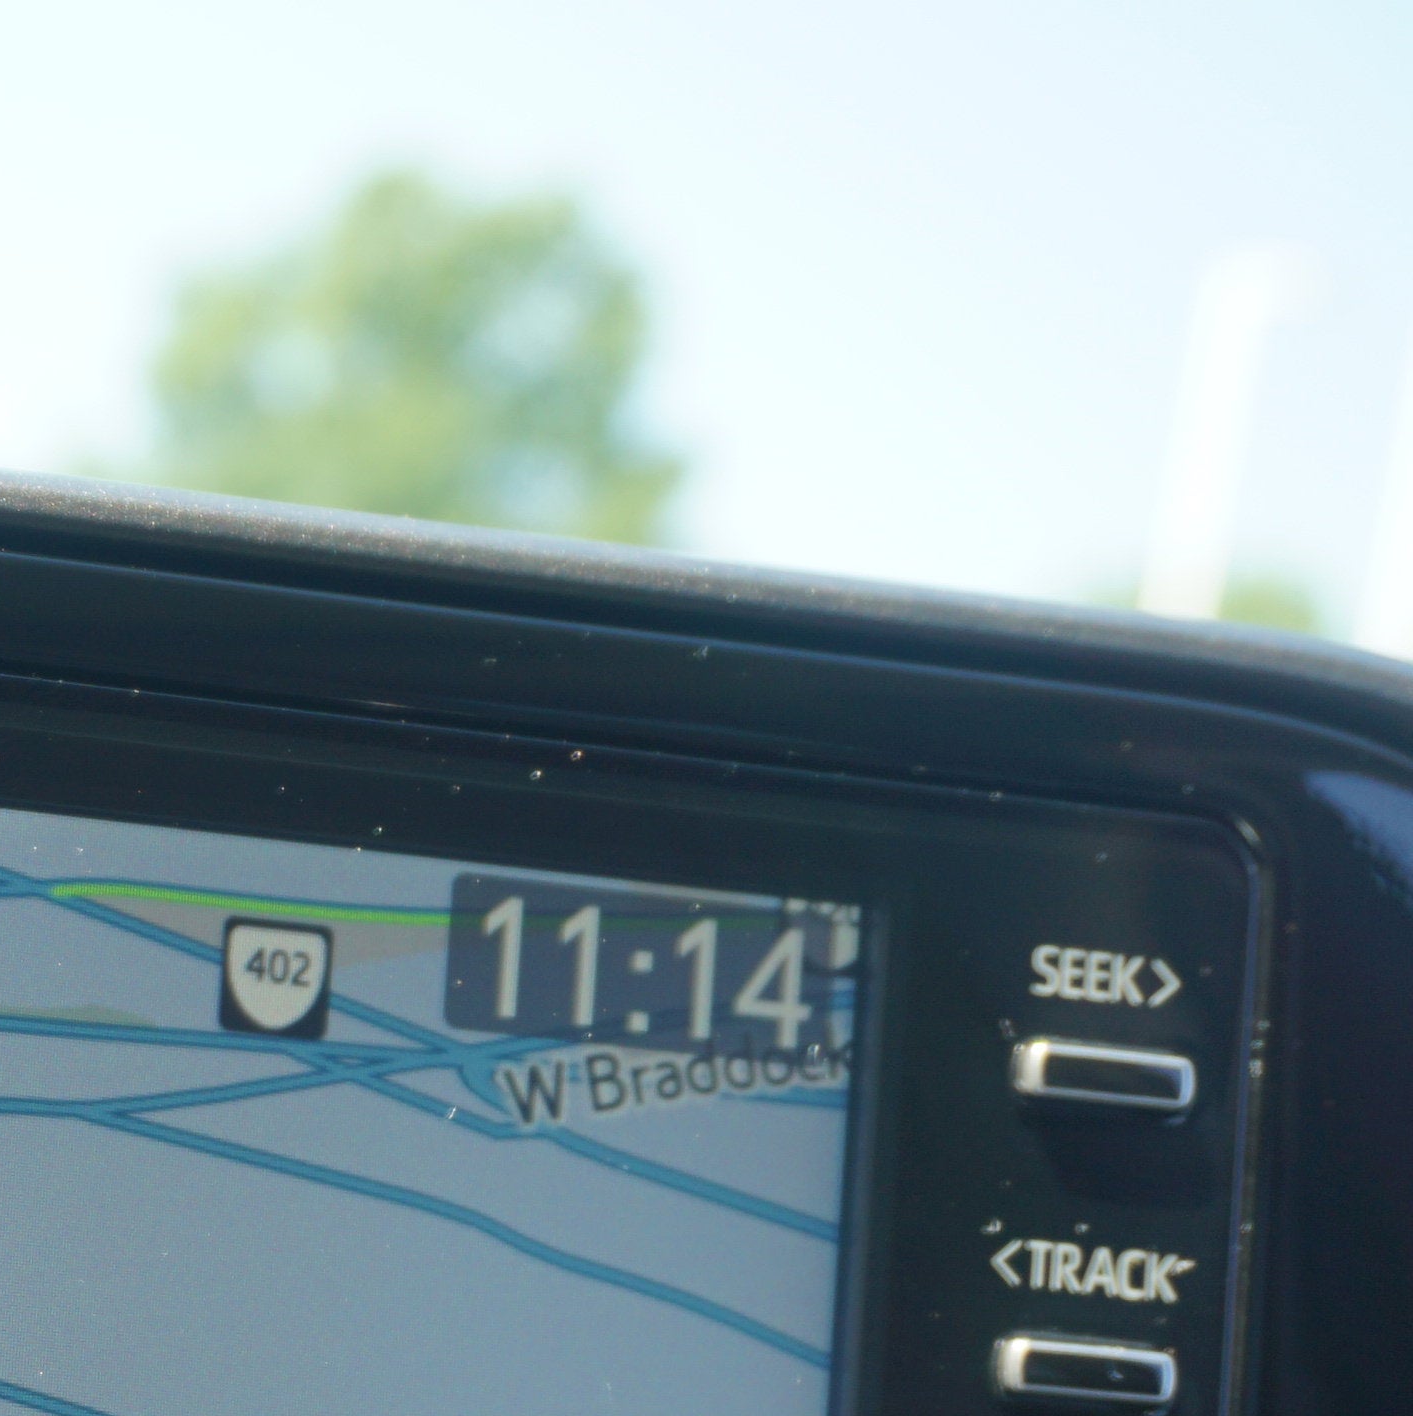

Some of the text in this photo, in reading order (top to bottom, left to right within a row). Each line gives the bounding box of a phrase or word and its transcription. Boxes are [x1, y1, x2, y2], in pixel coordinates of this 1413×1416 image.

[245, 949, 312, 989] 402
[482, 896, 812, 1051] 11:14
[1030, 943, 1146, 1007] SEEK
[504, 1060, 566, 1125] W
[1025, 1239, 1181, 1305] TRACK
